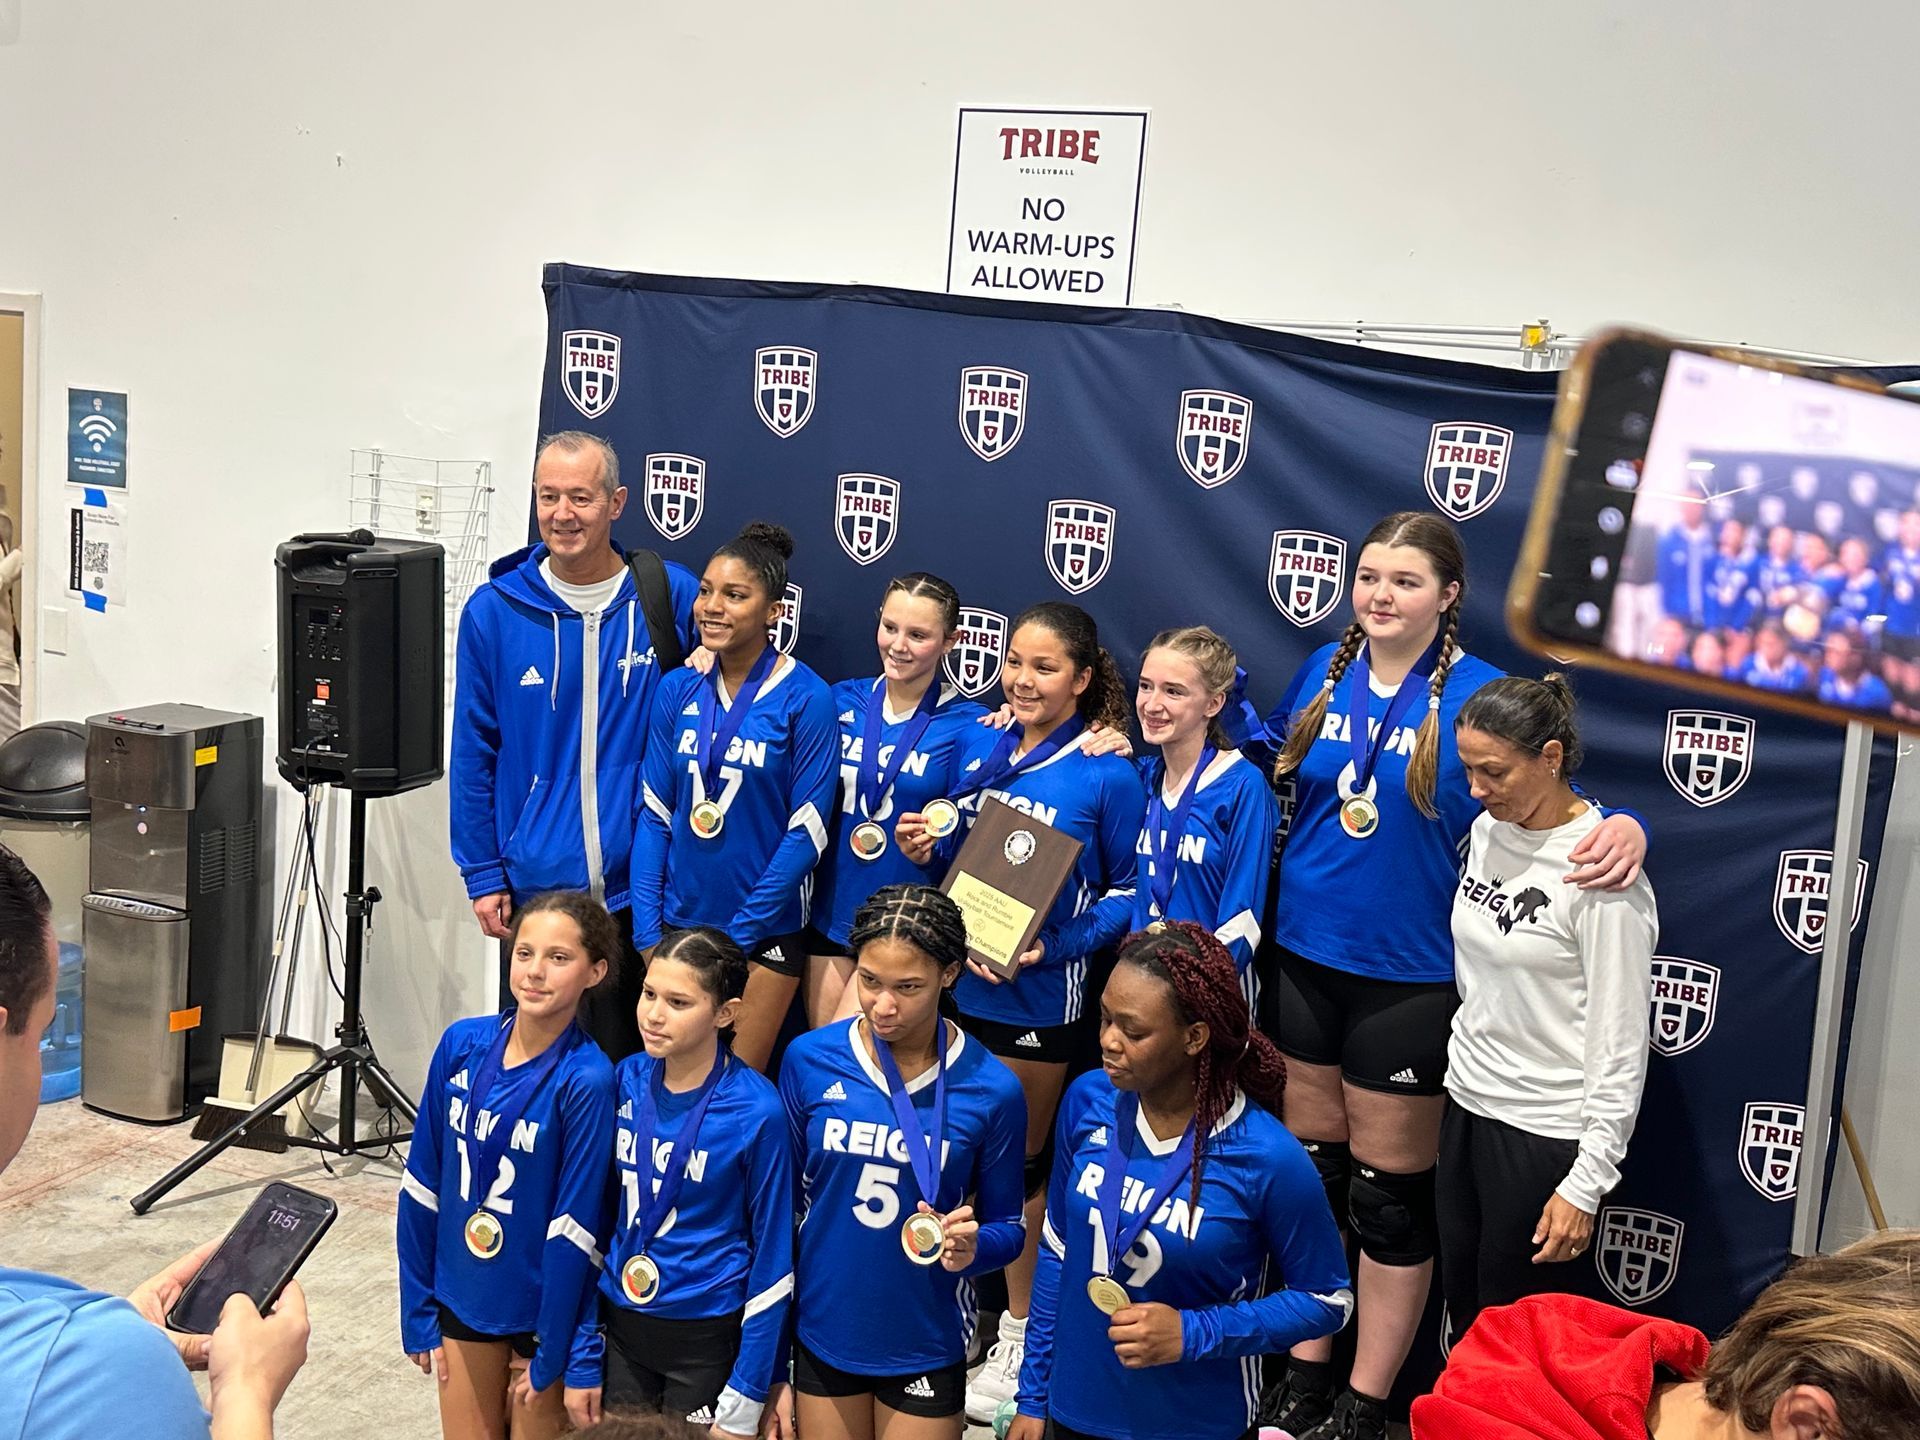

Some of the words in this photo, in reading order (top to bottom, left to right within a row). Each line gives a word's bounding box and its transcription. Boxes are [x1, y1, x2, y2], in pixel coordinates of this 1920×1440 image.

[999, 127, 1100, 164] TRIBE
[1019, 168, 1074, 176] VOLLEYBALL
[1021, 197, 1065, 222] NO
[967, 229, 1115, 260] WARM-UPS
[971, 265, 1104, 293] ALLOWED
[569, 351, 615, 371] TRIBE
[762, 368, 810, 388] TRIBE
[968, 389, 1019, 410] TRIBE
[1187, 412, 1243, 437] TRIBE
[1437, 445, 1501, 469] TRIBE
[652, 474, 698, 494] TRIBE
[843, 495, 892, 517] TRIBE
[1054, 521, 1107, 545] TRIBE
[1279, 552, 1338, 577] TRIBE
[959, 629, 1000, 651] RIBE
[1675, 731, 1744, 755] TRIBE
[688, 760, 743, 815] 17
[1786, 874, 1830, 895] TRI
[994, 897, 1007, 907] AAU
[1462, 876, 1524, 922] REIGN
[974, 936, 1007, 959] Champions
[1652, 980, 1709, 1006] RIBE
[1752, 1124, 1802, 1147] TRIB
[456, 1137, 514, 1214] 12
[852, 1162, 900, 1229] 5
[268, 1210, 300, 1231] 11:51
[1088, 1206, 1163, 1288] 19
[1607, 1228, 1672, 1256] TRIBE
[904, 1386, 935, 1397] adidas
